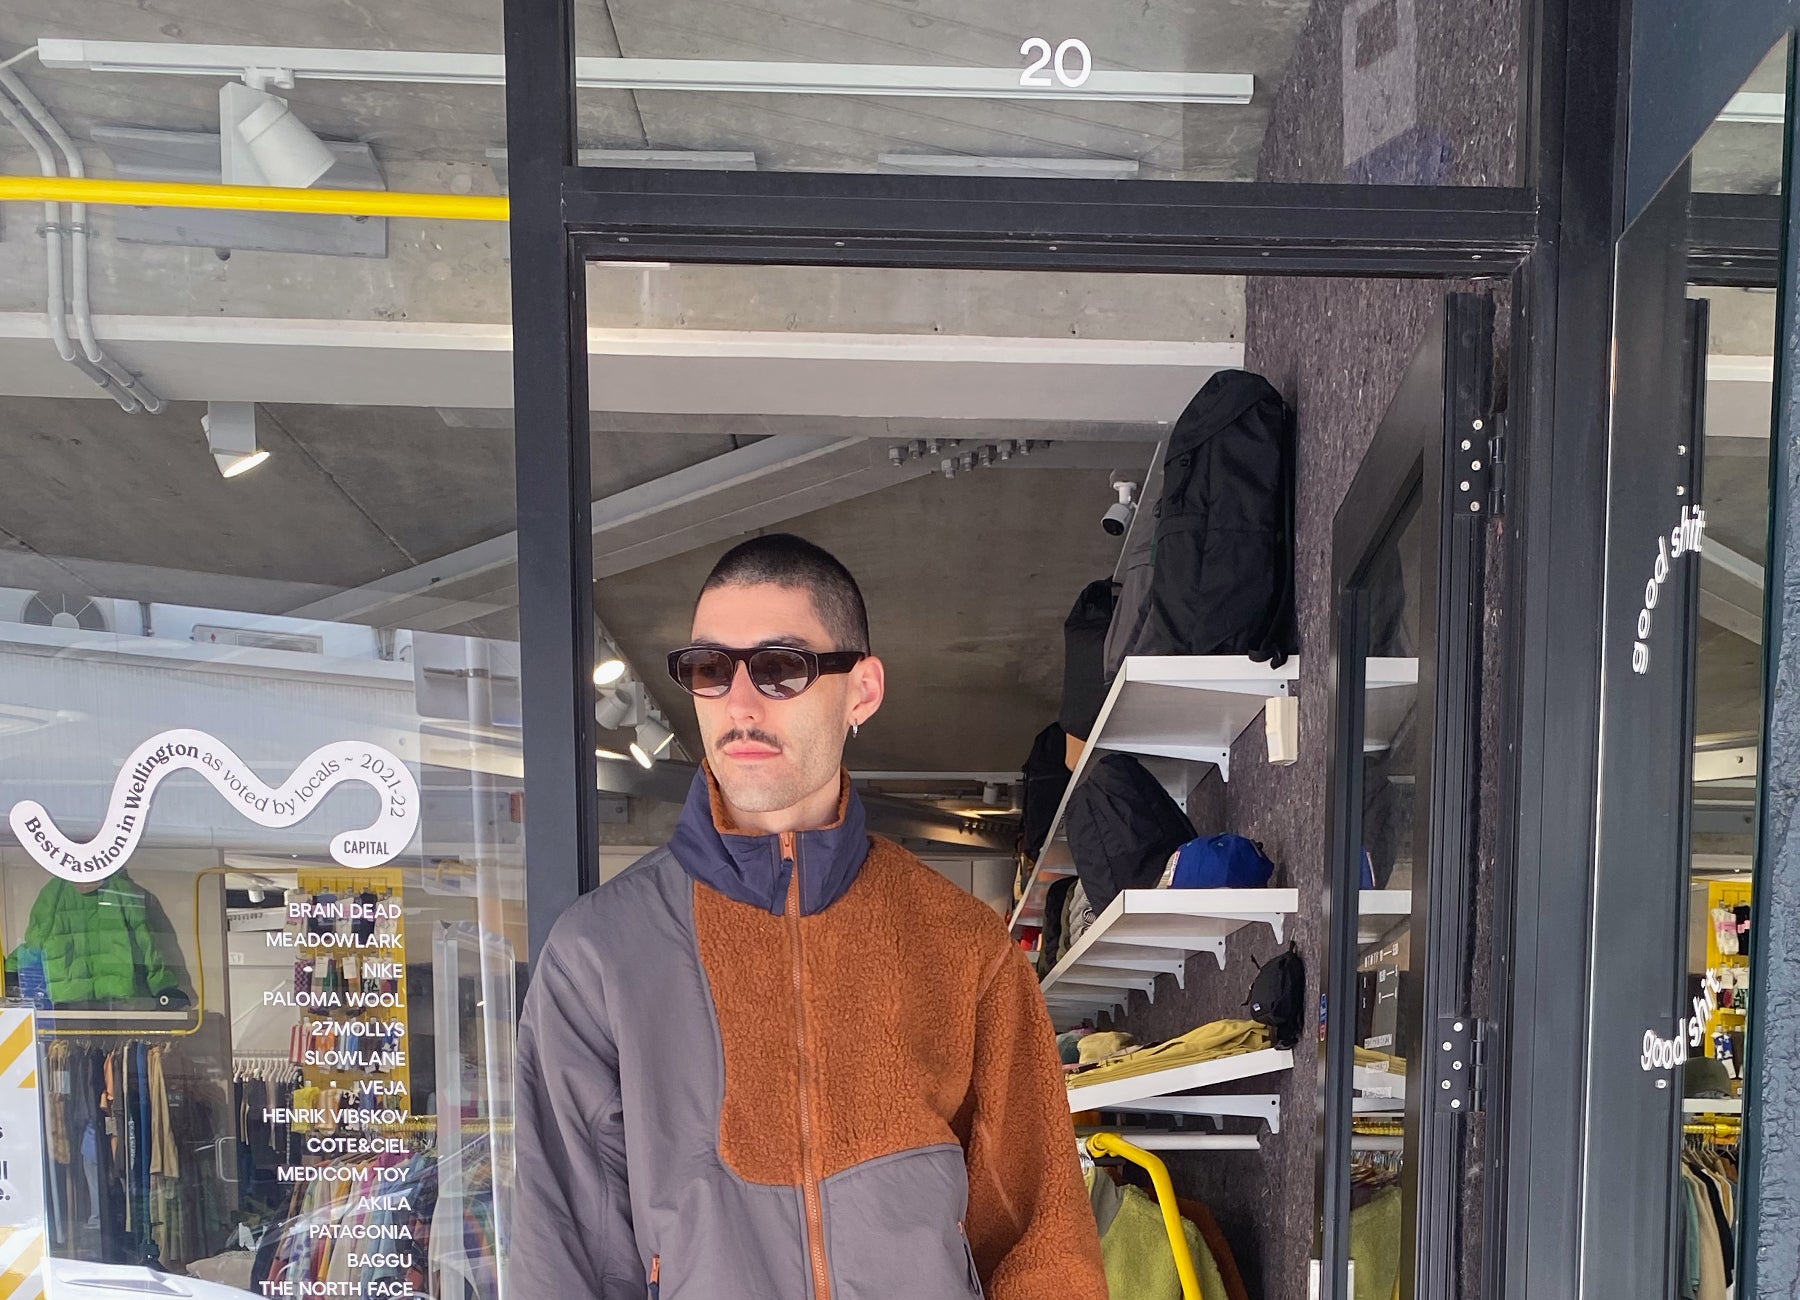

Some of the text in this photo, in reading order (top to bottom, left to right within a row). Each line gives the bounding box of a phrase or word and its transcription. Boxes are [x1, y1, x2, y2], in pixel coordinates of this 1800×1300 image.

[1019, 37, 1092, 88] 20
[1632, 504, 1706, 675] good shit
[201, 751, 224, 773] as
[124, 741, 200, 811] Wellington
[297, 760, 341, 804] locals
[223, 769, 270, 814] voted
[361, 752, 407, 819] 2021-22
[272, 798, 297, 817] by
[116, 817, 136, 838] in
[24, 816, 60, 859] Best
[60, 836, 125, 874] Fashion
[343, 839, 390, 856] CAPITAL
[289, 902, 402, 920] BRAIN DEAD
[266, 932, 404, 949] MEADOWLARK
[362, 963, 404, 979] NIKE
[263, 991, 405, 1009] PALOMA WOOL
[1640, 968, 1722, 1071] good shit
[311, 1021, 405, 1038] 27MOLLYS
[304, 1050, 406, 1067] SLOWLANE
[360, 1080, 407, 1096] VEJA
[263, 1108, 408, 1125] HENRIK VIBSKOV
[306, 1138, 410, 1154] COTE&CIEL
[277, 1166, 410, 1183] MEDICOM TOY
[357, 1196, 412, 1211] AKILA
[309, 1224, 412, 1240] PATAGONIA
[347, 1253, 412, 1268] BAGGU
[259, 1281, 413, 1297] THE NORTH FACE
